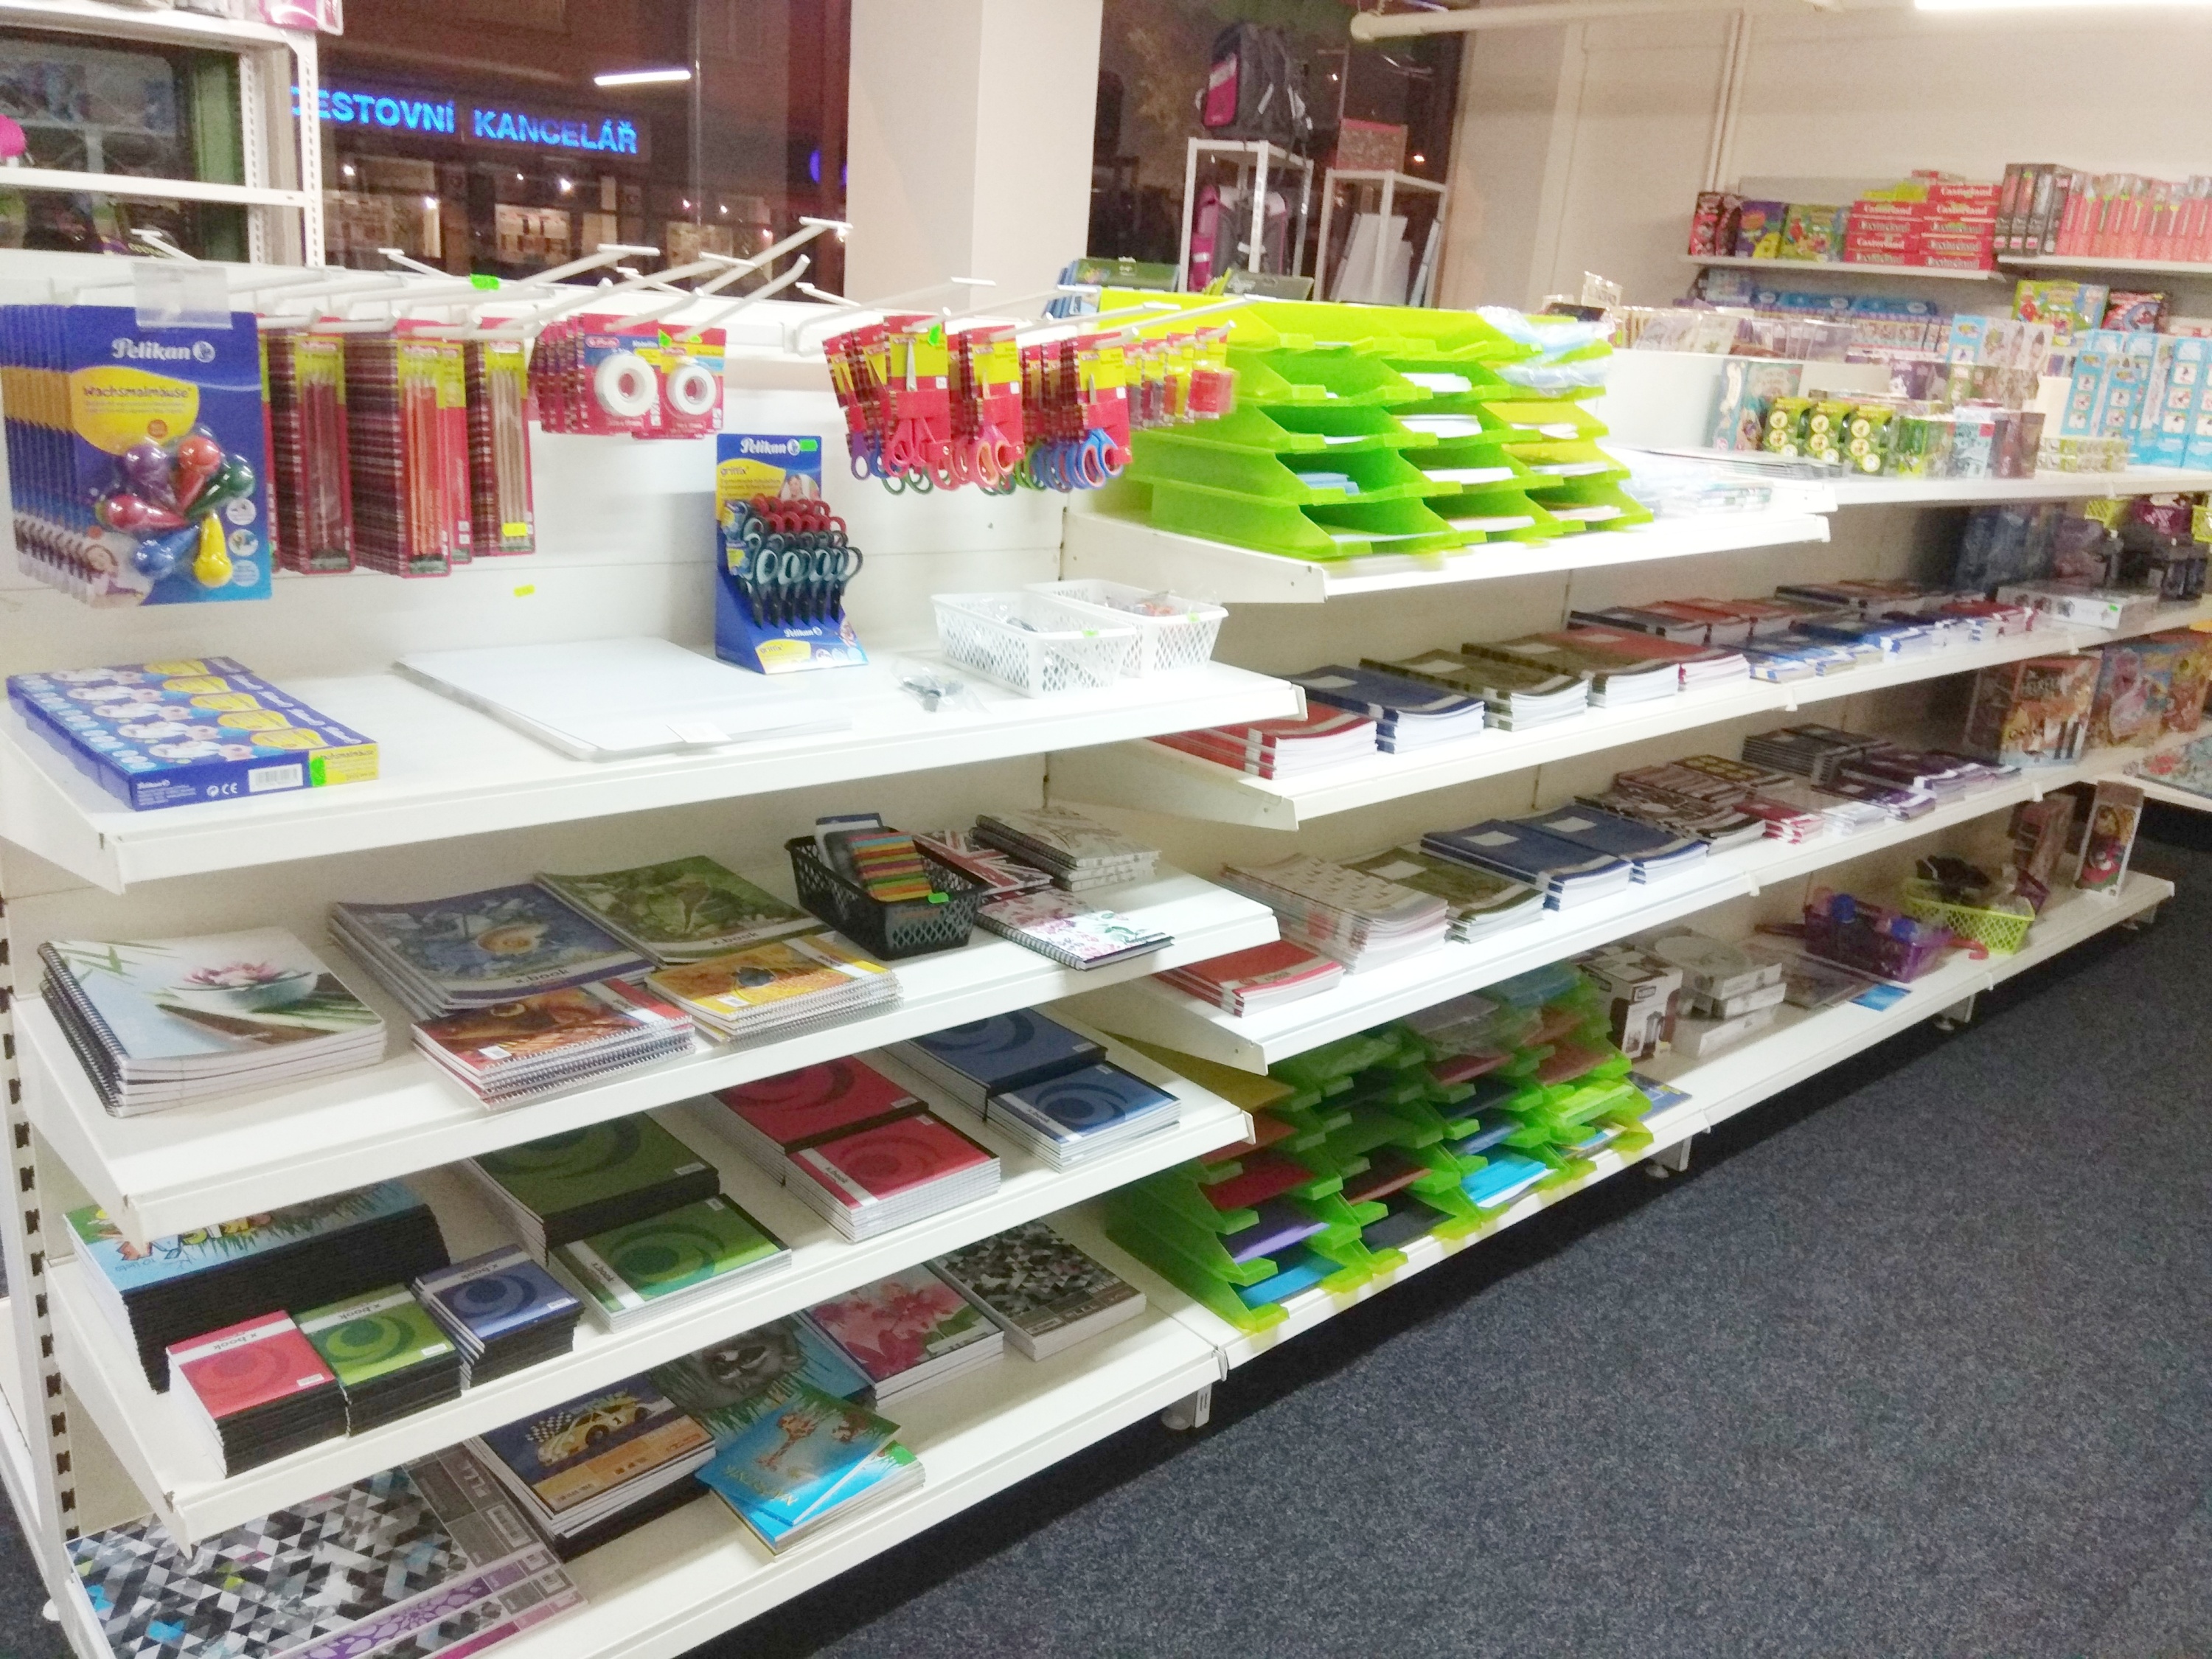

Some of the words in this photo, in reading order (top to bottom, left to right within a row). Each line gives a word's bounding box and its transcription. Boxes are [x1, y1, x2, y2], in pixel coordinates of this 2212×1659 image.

[473, 108, 639, 155] KANCELÁŘ
[111, 337, 192, 361] Pelikan
[740, 437, 787, 455] Pelikan
[783, 627, 814, 638] Pelikan
